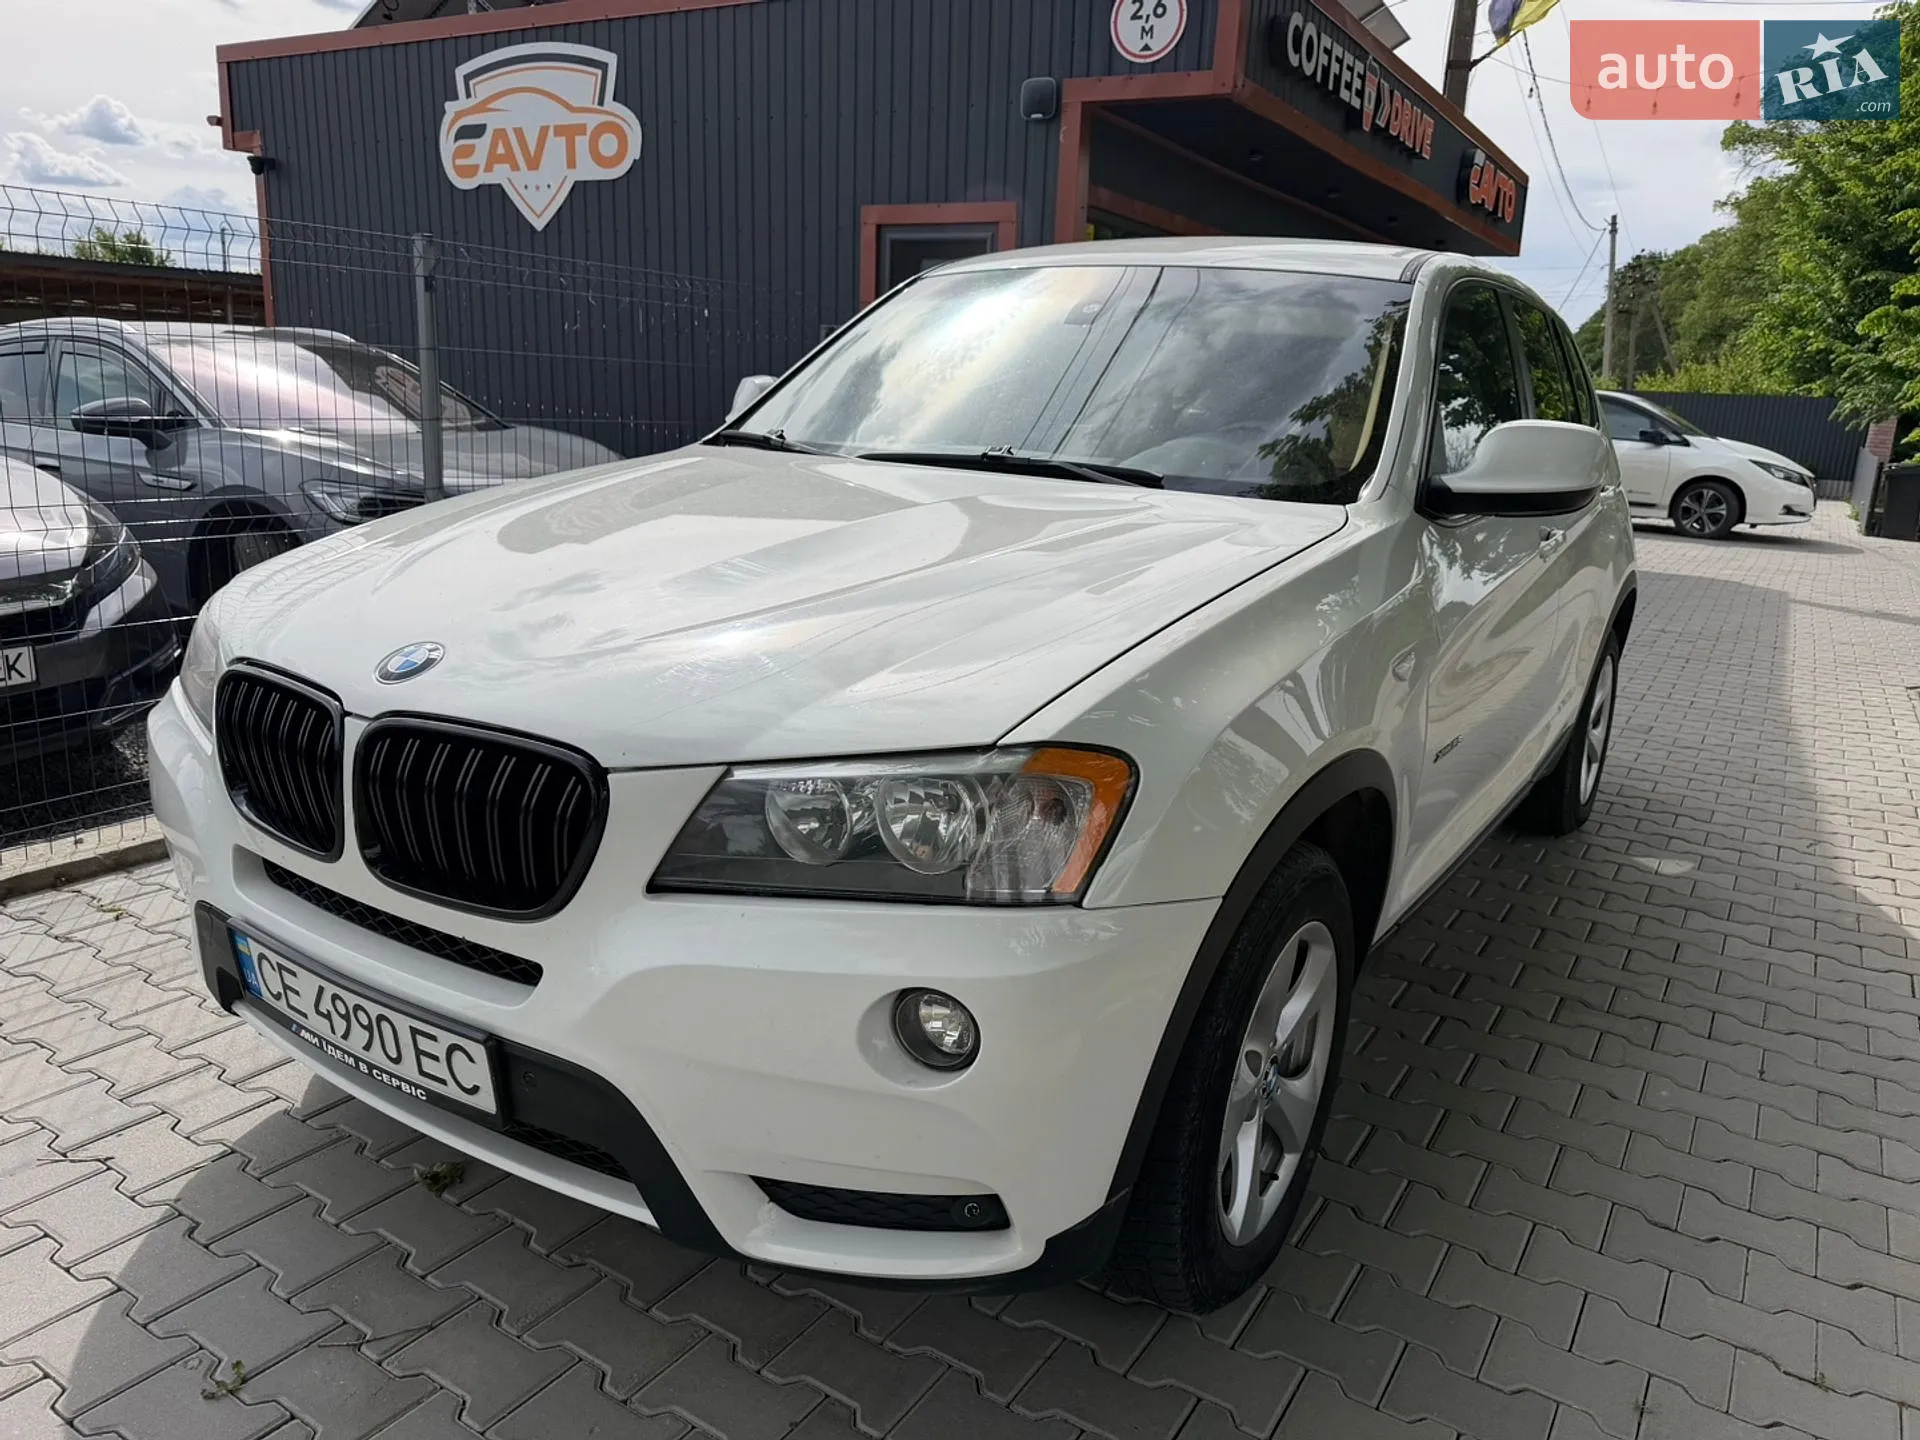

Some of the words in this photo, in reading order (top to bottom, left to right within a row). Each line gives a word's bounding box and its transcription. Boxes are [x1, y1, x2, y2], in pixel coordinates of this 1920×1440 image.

[1130, 0, 1167, 24] 2,6
[1287, 11, 1365, 110] COFFEE
[1389, 90, 1434, 160] DRIVE
[257, 951, 309, 1020] CE
[313, 984, 402, 1066] 4990
[409, 1025, 480, 1096] EC
